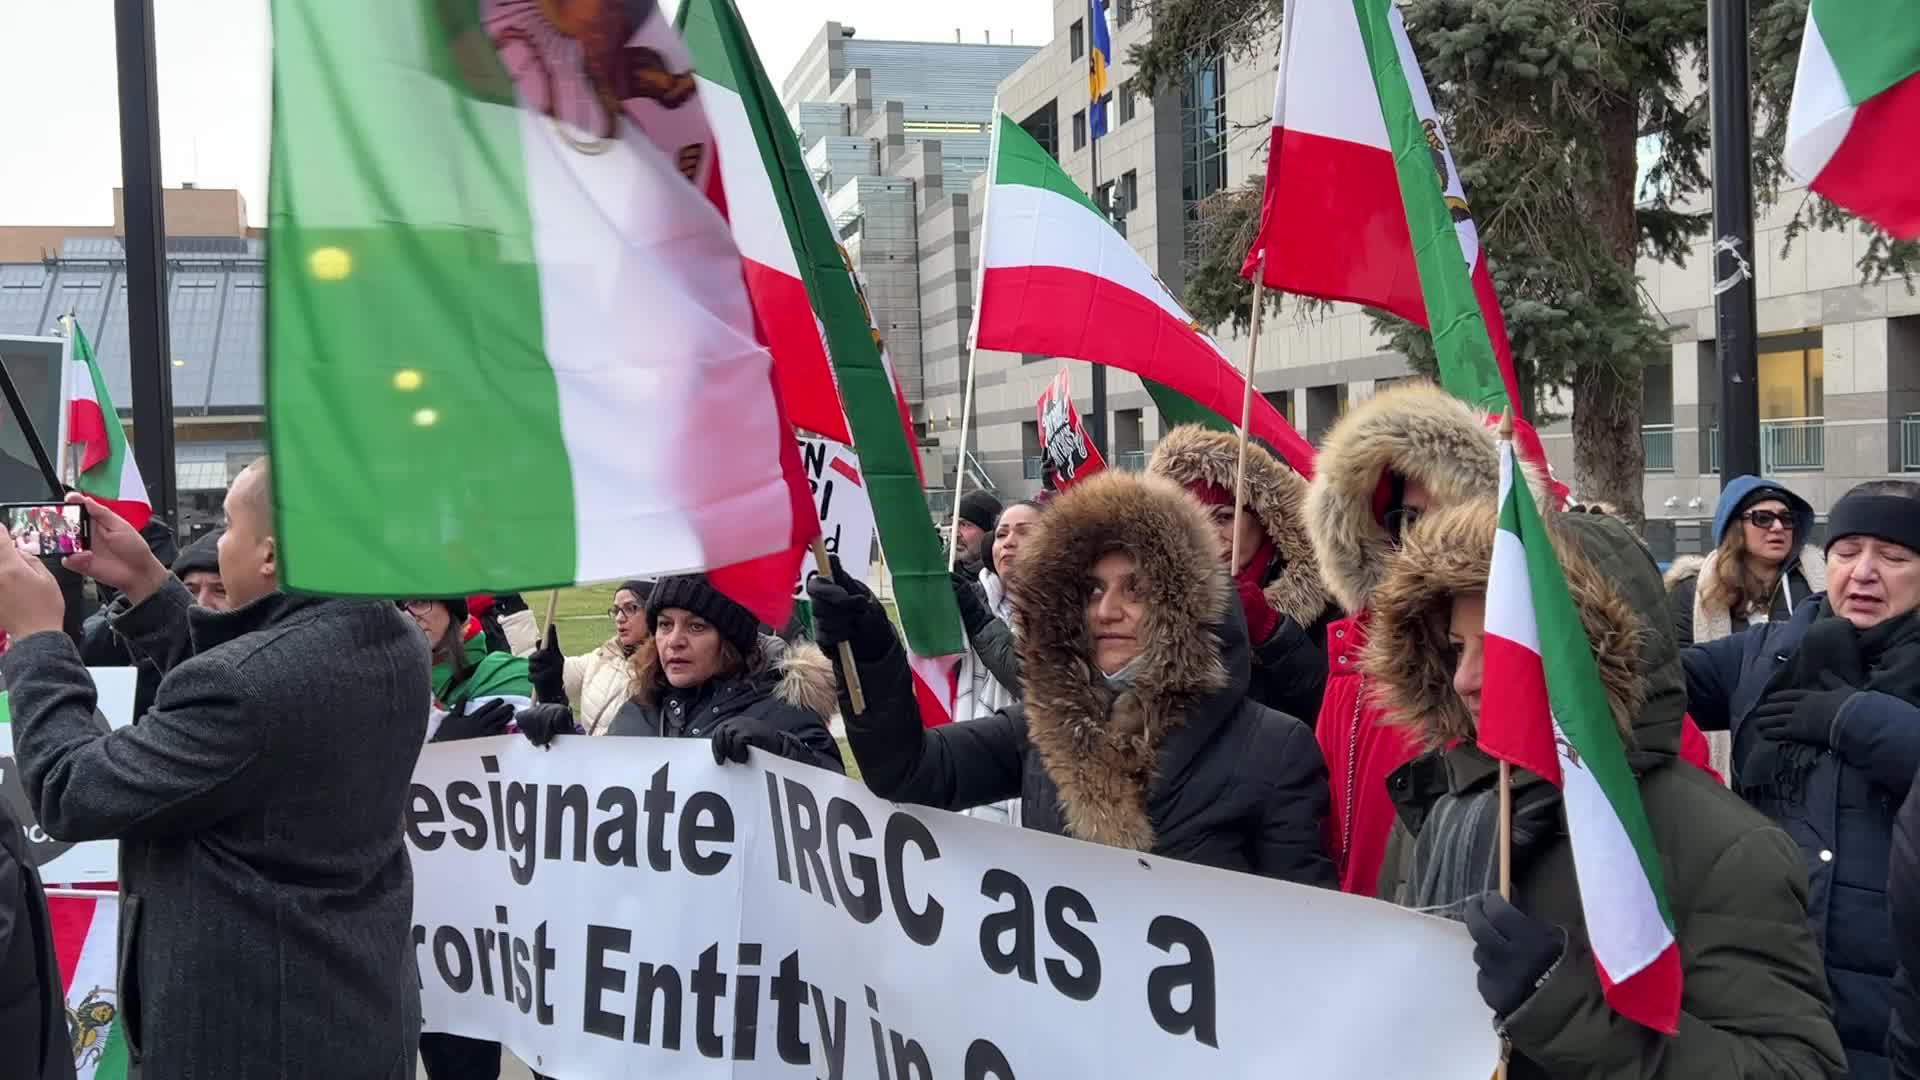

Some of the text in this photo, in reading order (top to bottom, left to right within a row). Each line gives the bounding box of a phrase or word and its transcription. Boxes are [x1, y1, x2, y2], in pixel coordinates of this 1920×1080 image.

[798, 441, 826, 479] N
[405, 755, 1219, 1049] esignate IRGC as a
[412, 905, 934, 1080] rorist Entity in
